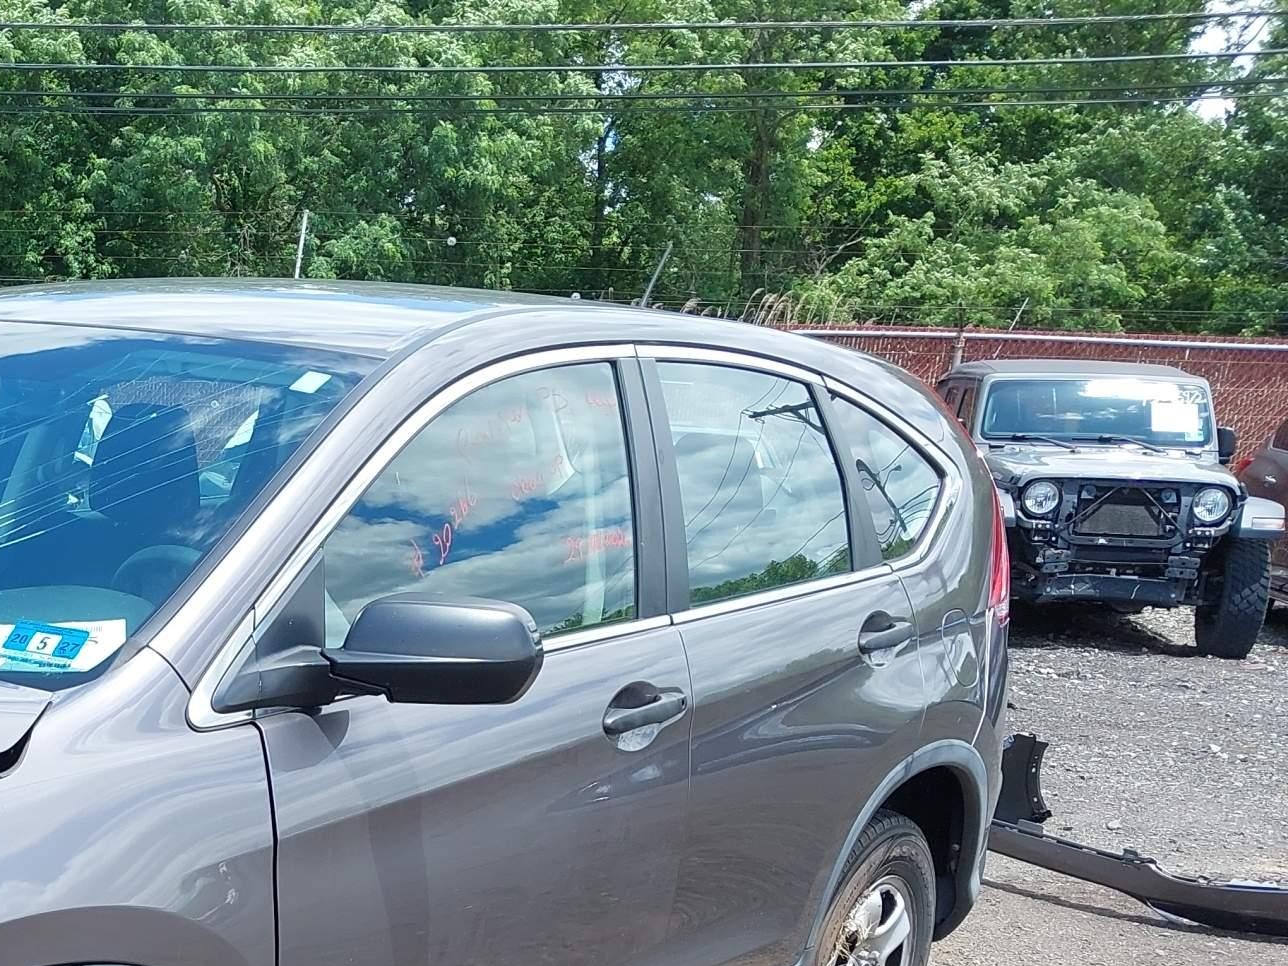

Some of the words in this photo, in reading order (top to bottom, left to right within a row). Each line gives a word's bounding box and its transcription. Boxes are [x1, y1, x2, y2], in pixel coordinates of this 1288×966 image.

[11, 633, 29, 645] 20
[36, 636, 51, 651] 5
[59, 641, 81, 653] 27
